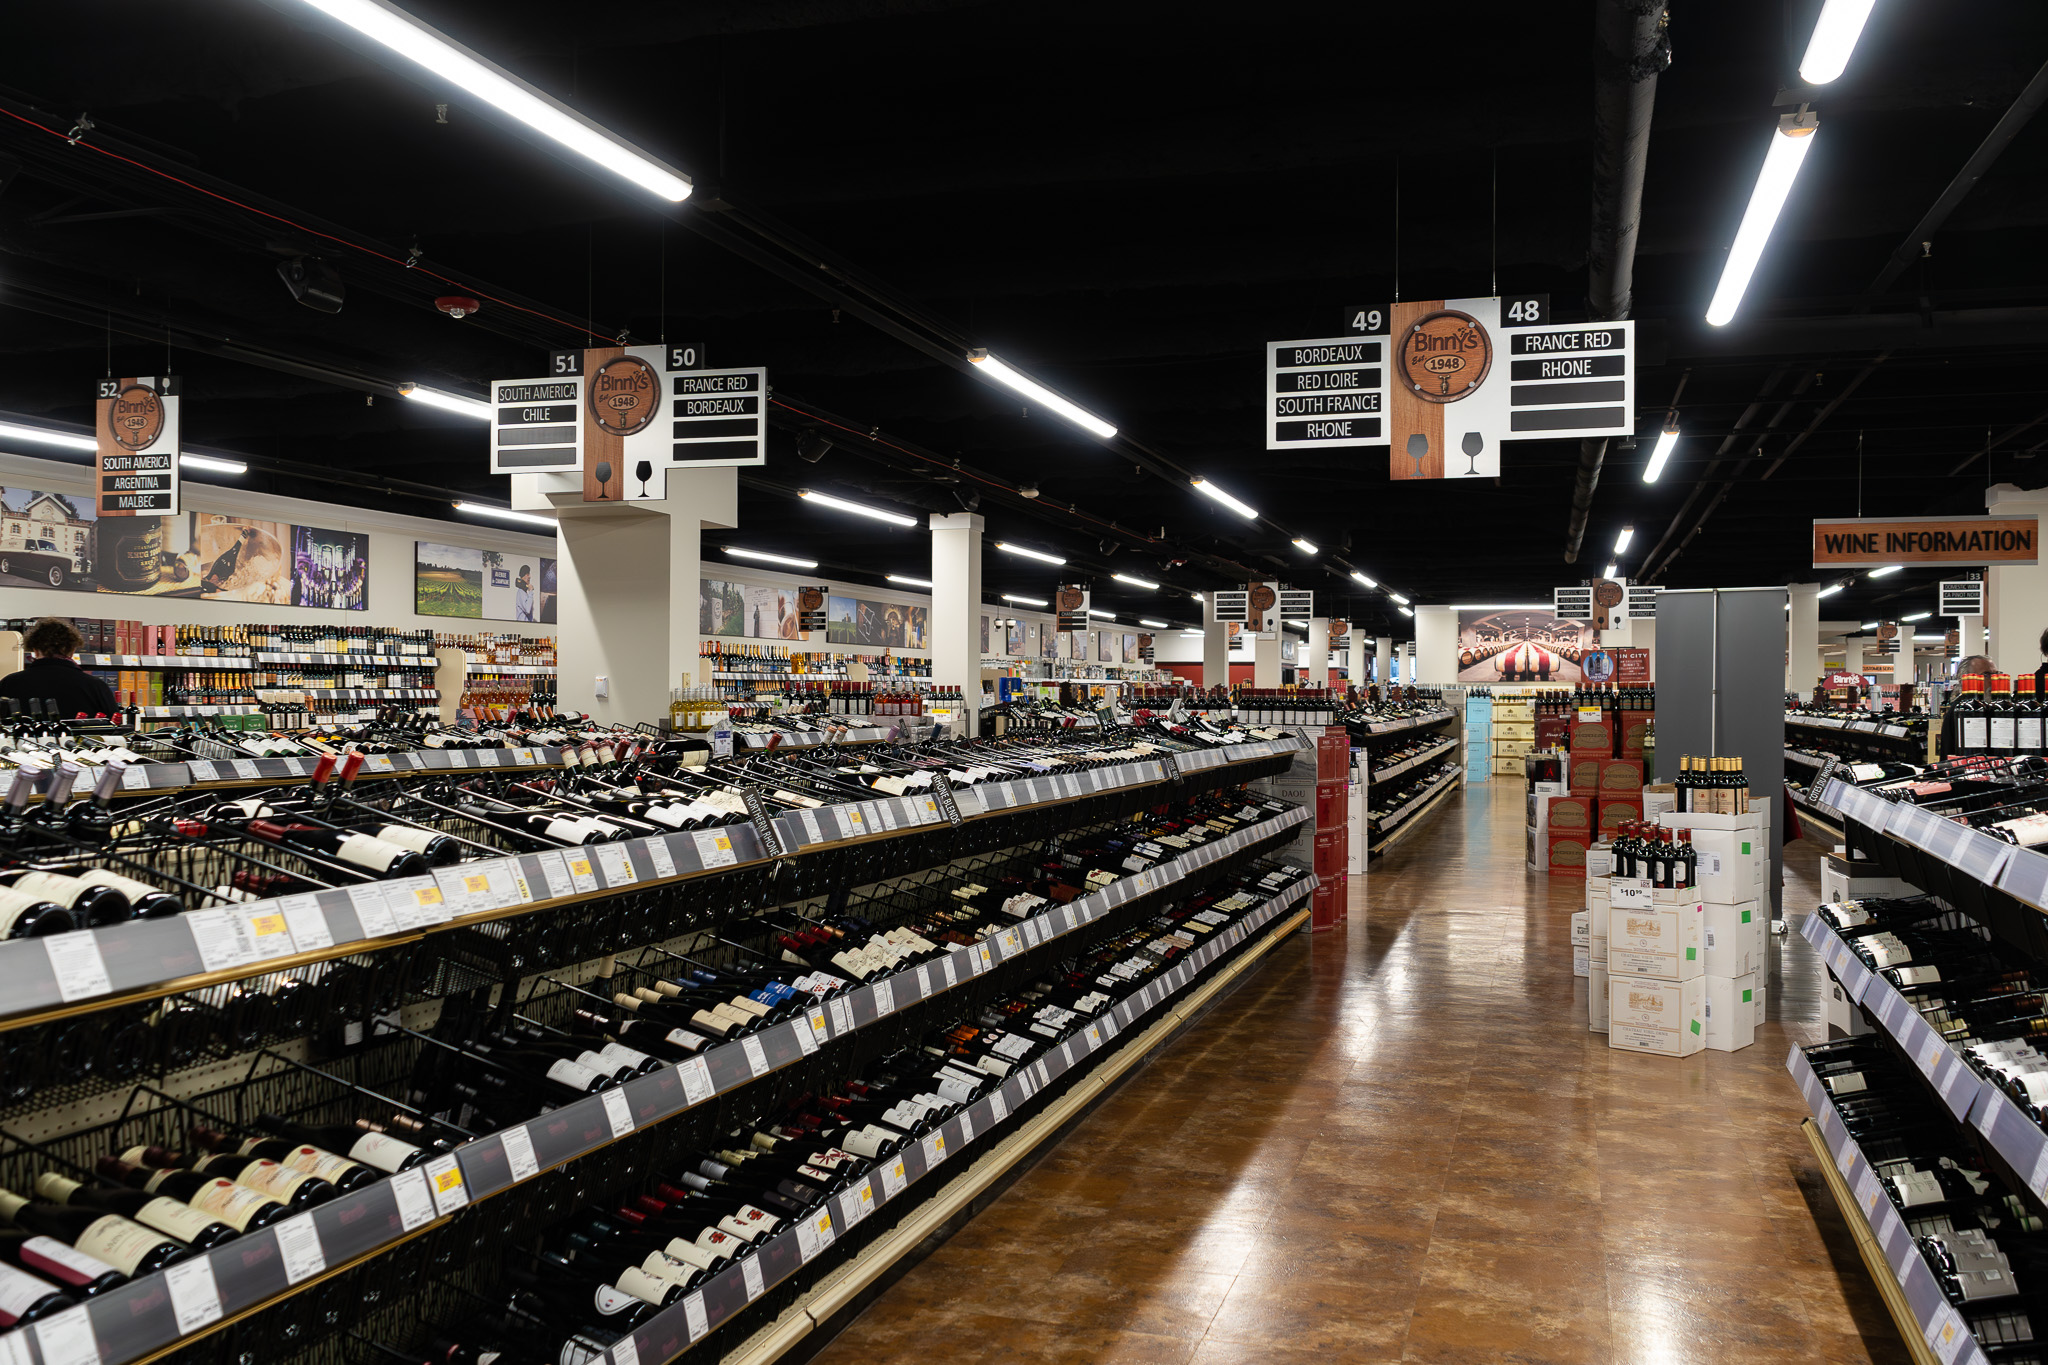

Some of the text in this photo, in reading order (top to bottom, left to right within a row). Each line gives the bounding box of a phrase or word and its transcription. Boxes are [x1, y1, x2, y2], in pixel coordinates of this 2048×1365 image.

[1508, 301, 1540, 321] 48
[1352, 310, 1382, 331] 49
[1415, 326, 1478, 353] Binny's
[1525, 332, 1612, 351] FRANCE RED
[672, 348, 696, 367] 50
[1295, 345, 1363, 364] BORDEAUX
[555, 354, 577, 373] 51
[1430, 357, 1460, 370] 1948
[1541, 360, 1592, 377] RHONE
[600, 370, 649, 393] Binny's
[682, 376, 748, 393] FRANCE RED
[1297, 371, 1359, 390] RED LOIRE
[100, 382, 118, 397] 52
[499, 384, 577, 401] SOUTH AMERICA
[612, 396, 635, 407] 1948
[686, 399, 745, 415] BORDEAUX
[1278, 394, 1378, 414] SOUTH FRANCE
[127, 418, 145, 427] 1948
[522, 407, 550, 421] CHILE
[1306, 421, 1352, 438] RHONE
[103, 456, 170, 470] SOUTH AMERICA
[114, 476, 159, 489] ARGENTINA
[118, 495, 155, 508] MALBEC
[1824, 529, 2031, 554] WINE INFORMATION
[1580, 579, 1591, 587] 35
[1969, 572, 1981, 580] 33
[1833, 672, 1860, 684] Binny's
[1172, 770, 1180, 780] RED
[1282, 789, 1306, 798] DAOU
[1809, 785, 1823, 802] COTES
[1816, 776, 1827, 787] DU
[932, 774, 960, 824] RHONE BLENDS
[745, 793, 780, 857] NORTHERN RHONE
[623, 861, 634, 879] NEW
[517, 878, 529, 899] NEW
